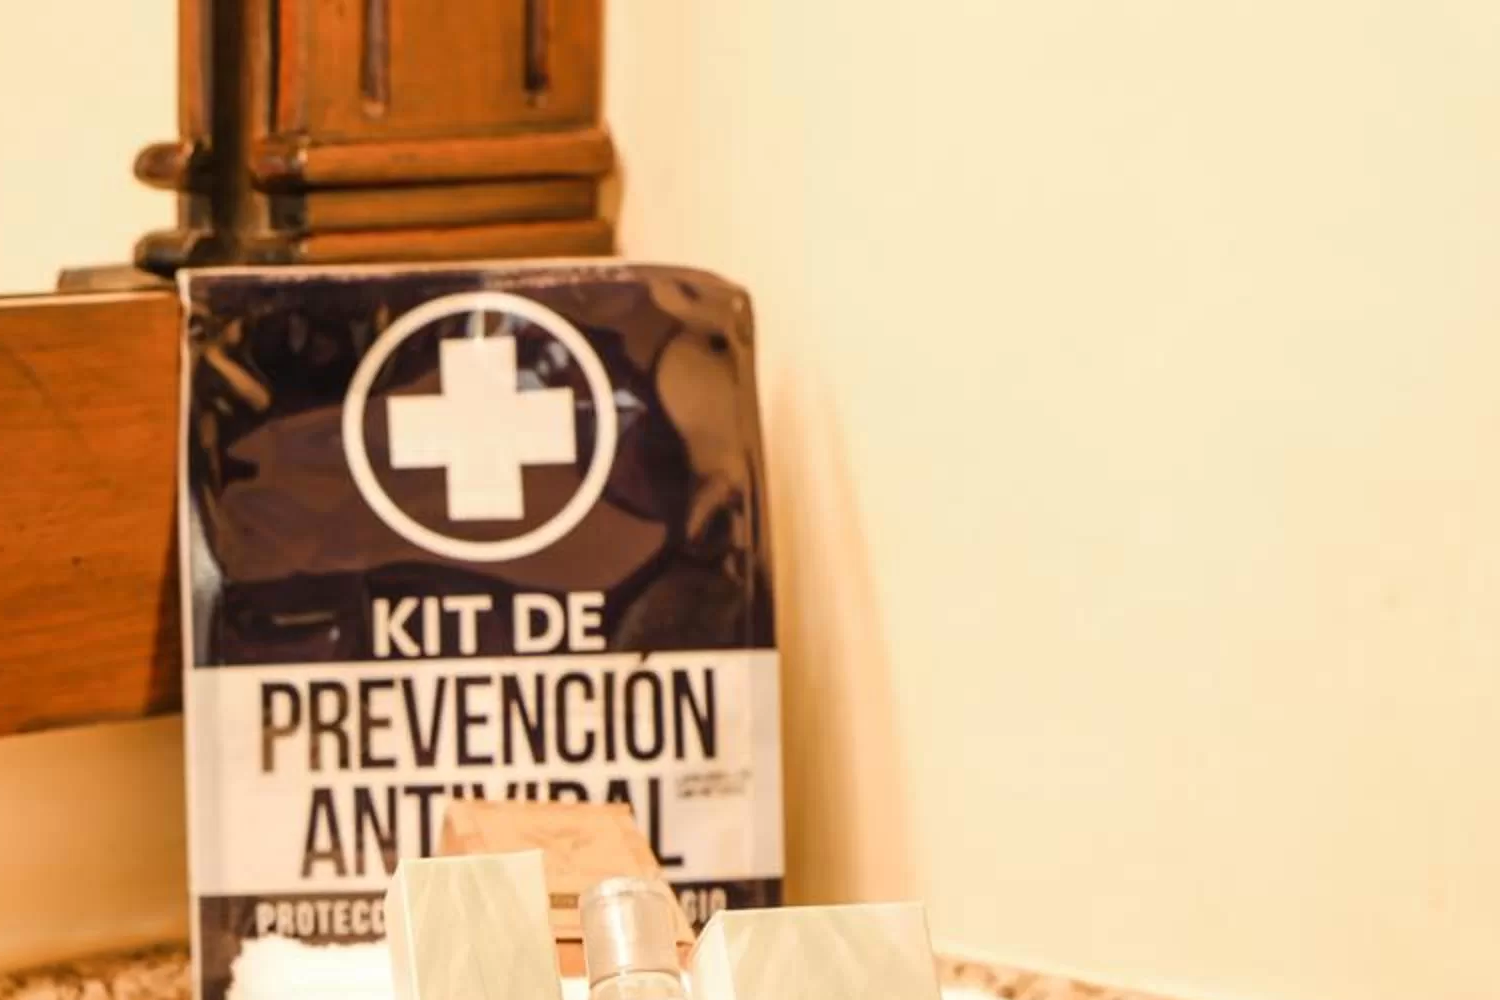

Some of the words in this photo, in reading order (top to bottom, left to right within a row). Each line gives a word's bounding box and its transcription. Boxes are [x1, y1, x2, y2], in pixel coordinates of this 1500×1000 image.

[372, 594, 492, 657] KIT
[513, 592, 606, 654] DE
[259, 652, 717, 773] PREVENCIÓN
